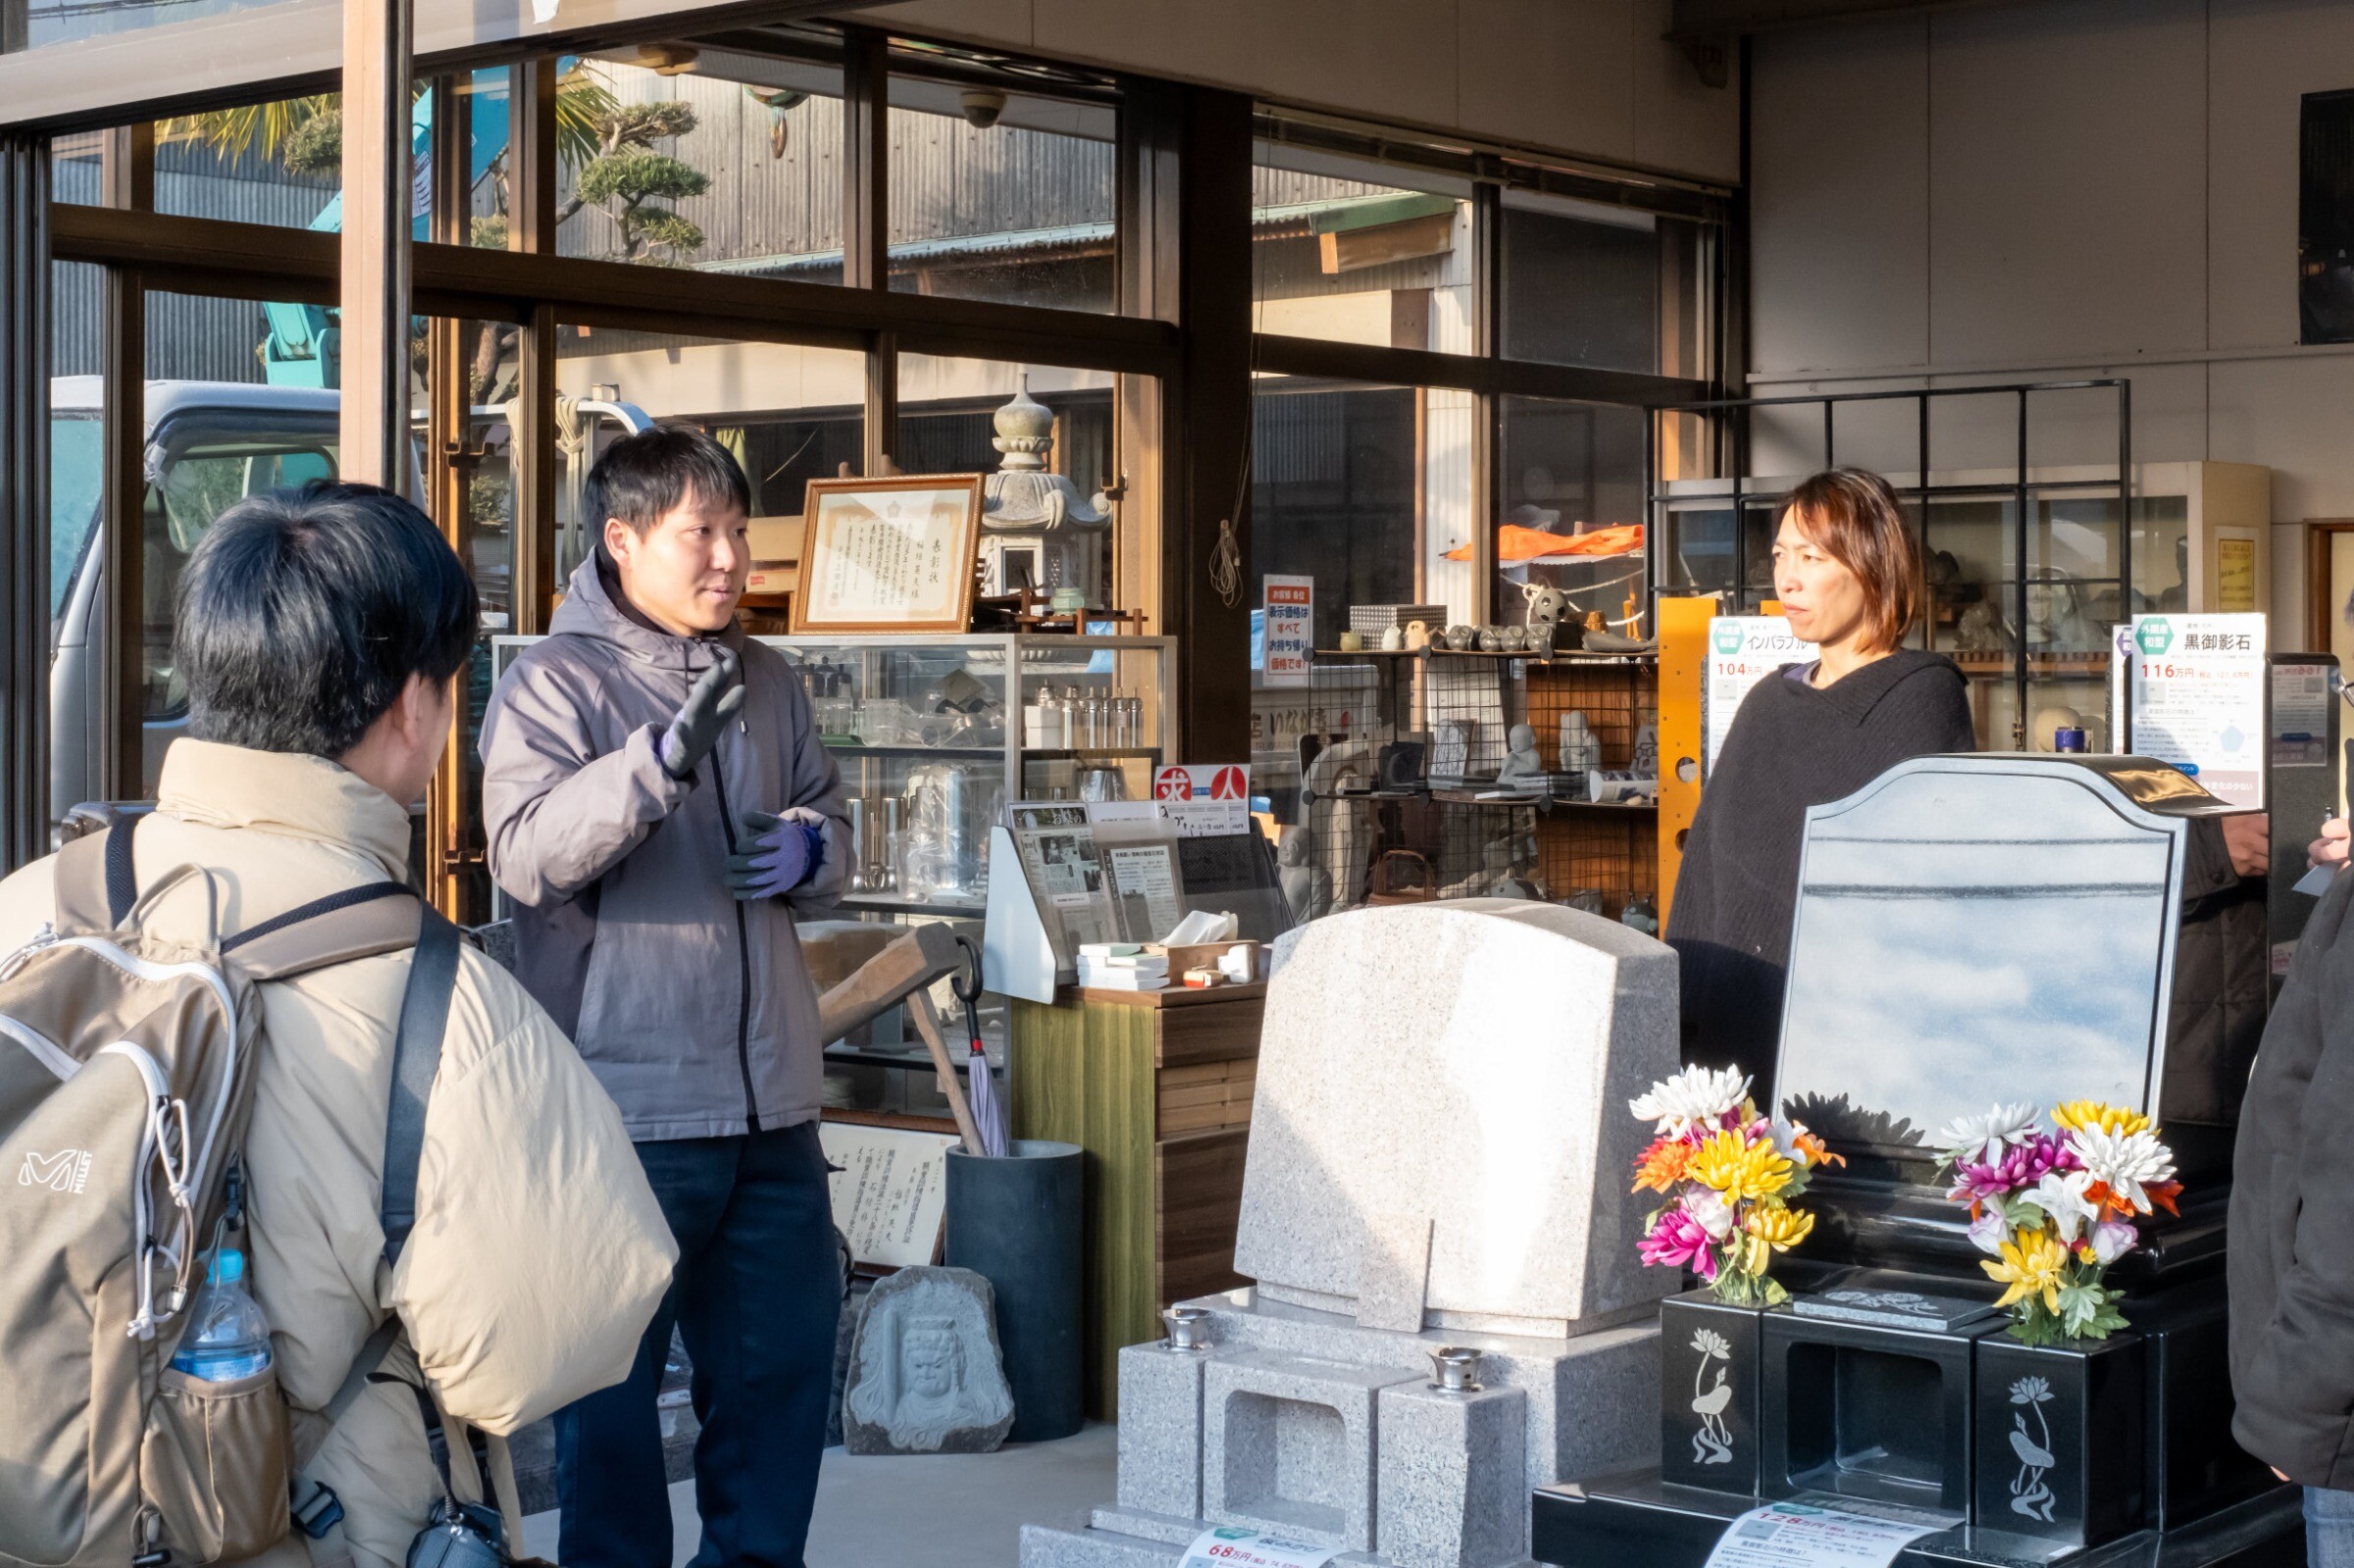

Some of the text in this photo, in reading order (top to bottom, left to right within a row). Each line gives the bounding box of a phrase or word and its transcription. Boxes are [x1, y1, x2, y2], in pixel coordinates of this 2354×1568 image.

[929, 537, 942, 583] 表彰状
[1269, 605, 1308, 619] 表示価格は
[1276, 623, 1301, 634] すべて
[2141, 624, 2169, 633] 外国産
[1268, 639, 1308, 652] お持ち帰り
[2144, 636, 2166, 648] 和型
[2184, 633, 2251, 650] 黒御影石
[1717, 663, 1763, 676] 104万円
[2141, 664, 2194, 679] 116万円
[1156, 769, 1191, 802] 求
[74, 1150, 93, 1194] MILLET
[1759, 1512, 1825, 1529] 128万円
[1208, 1543, 1253, 1562] 68万円
